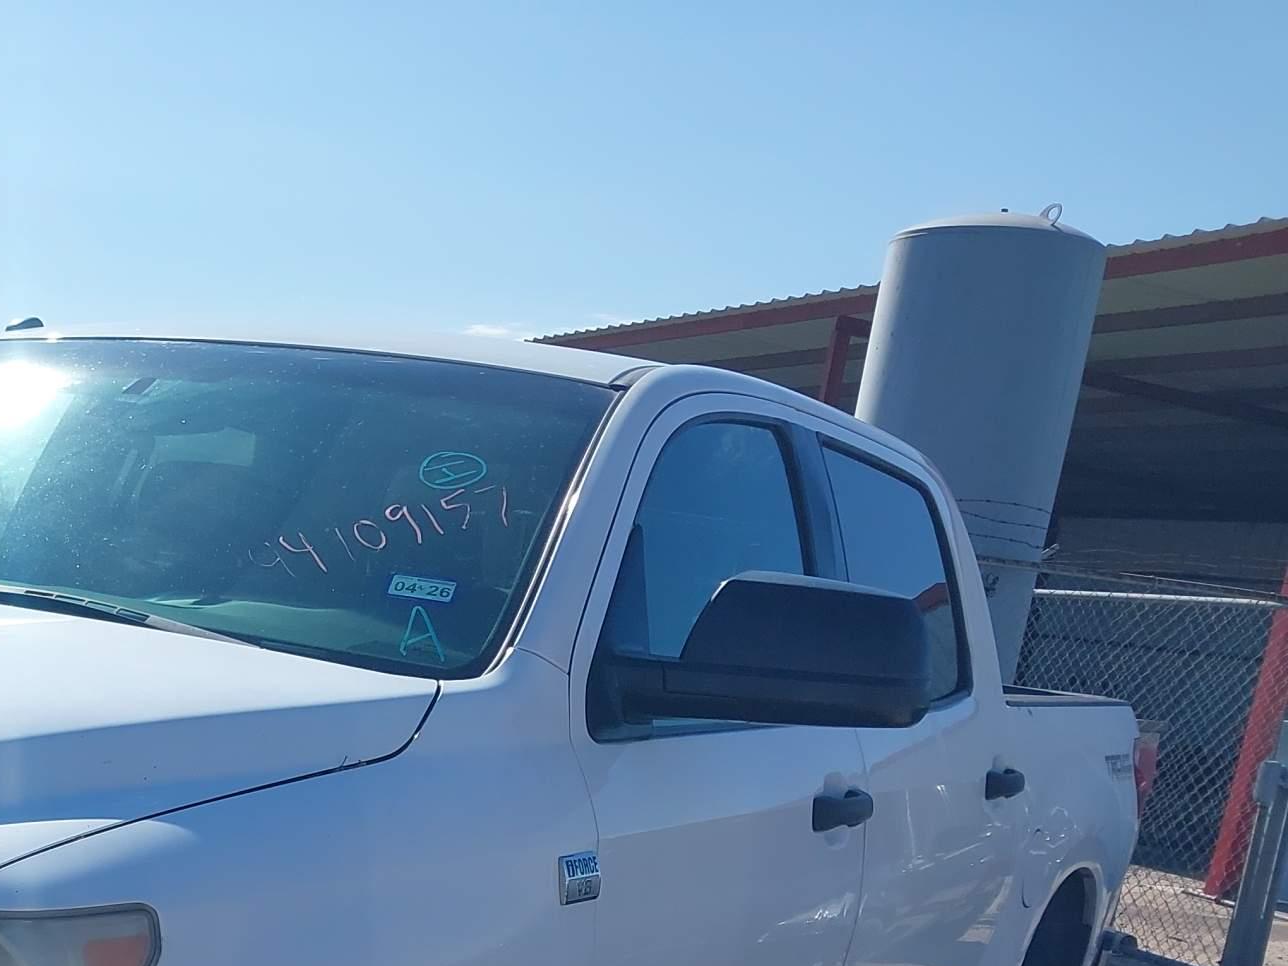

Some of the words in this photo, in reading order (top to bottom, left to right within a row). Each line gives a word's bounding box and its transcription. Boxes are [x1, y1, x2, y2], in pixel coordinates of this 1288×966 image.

[394, 581, 418, 594] 04
[426, 585, 451, 598] 26
[399, 605, 445, 662] A
